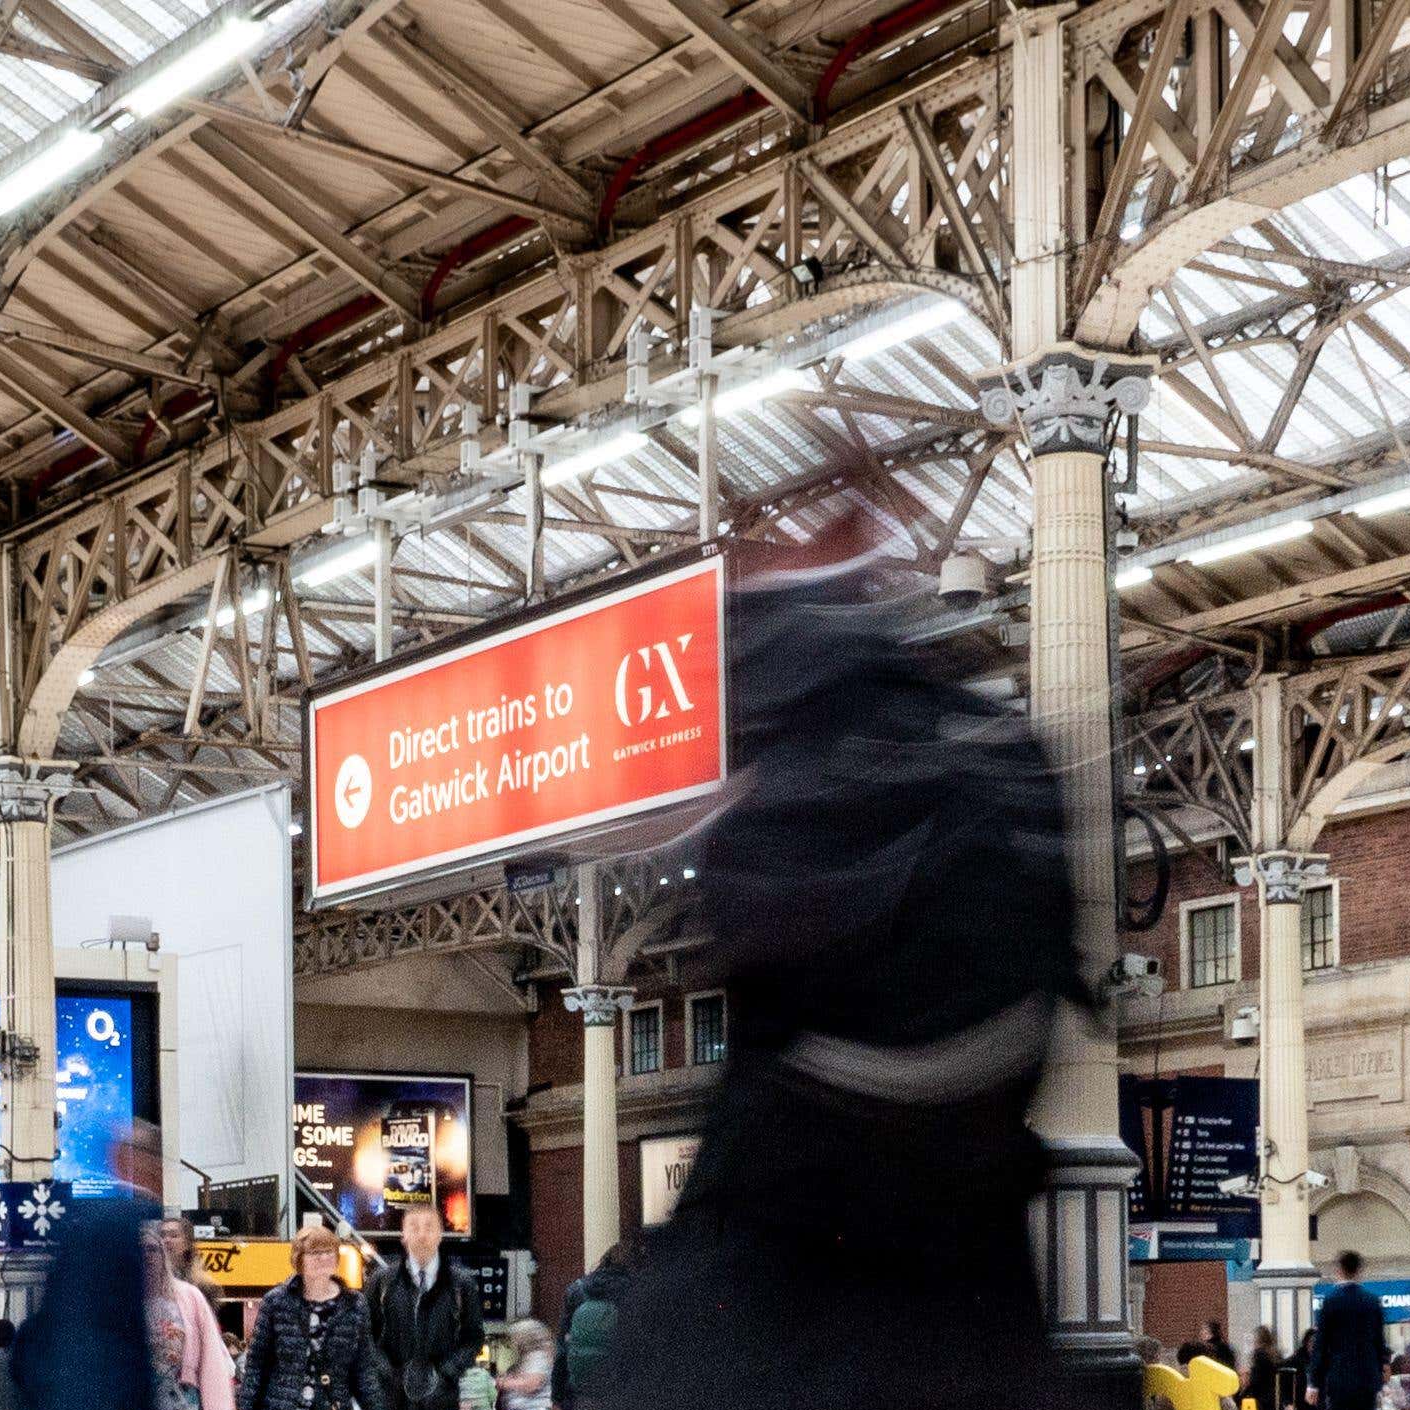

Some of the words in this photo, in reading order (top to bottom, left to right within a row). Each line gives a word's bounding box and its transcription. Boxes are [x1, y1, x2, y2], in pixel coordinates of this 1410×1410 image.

[615, 633, 695, 727] GX
[389, 719, 460, 769] Direct
[467, 694, 537, 743] trains
[544, 682, 574, 716] to
[613, 740, 657, 761] GATWICK
[659, 726, 702, 749] EXPRESS
[389, 763, 488, 824] Gatwick
[496, 734, 590, 794] Airport
[301, 1126, 354, 1147] SOME
